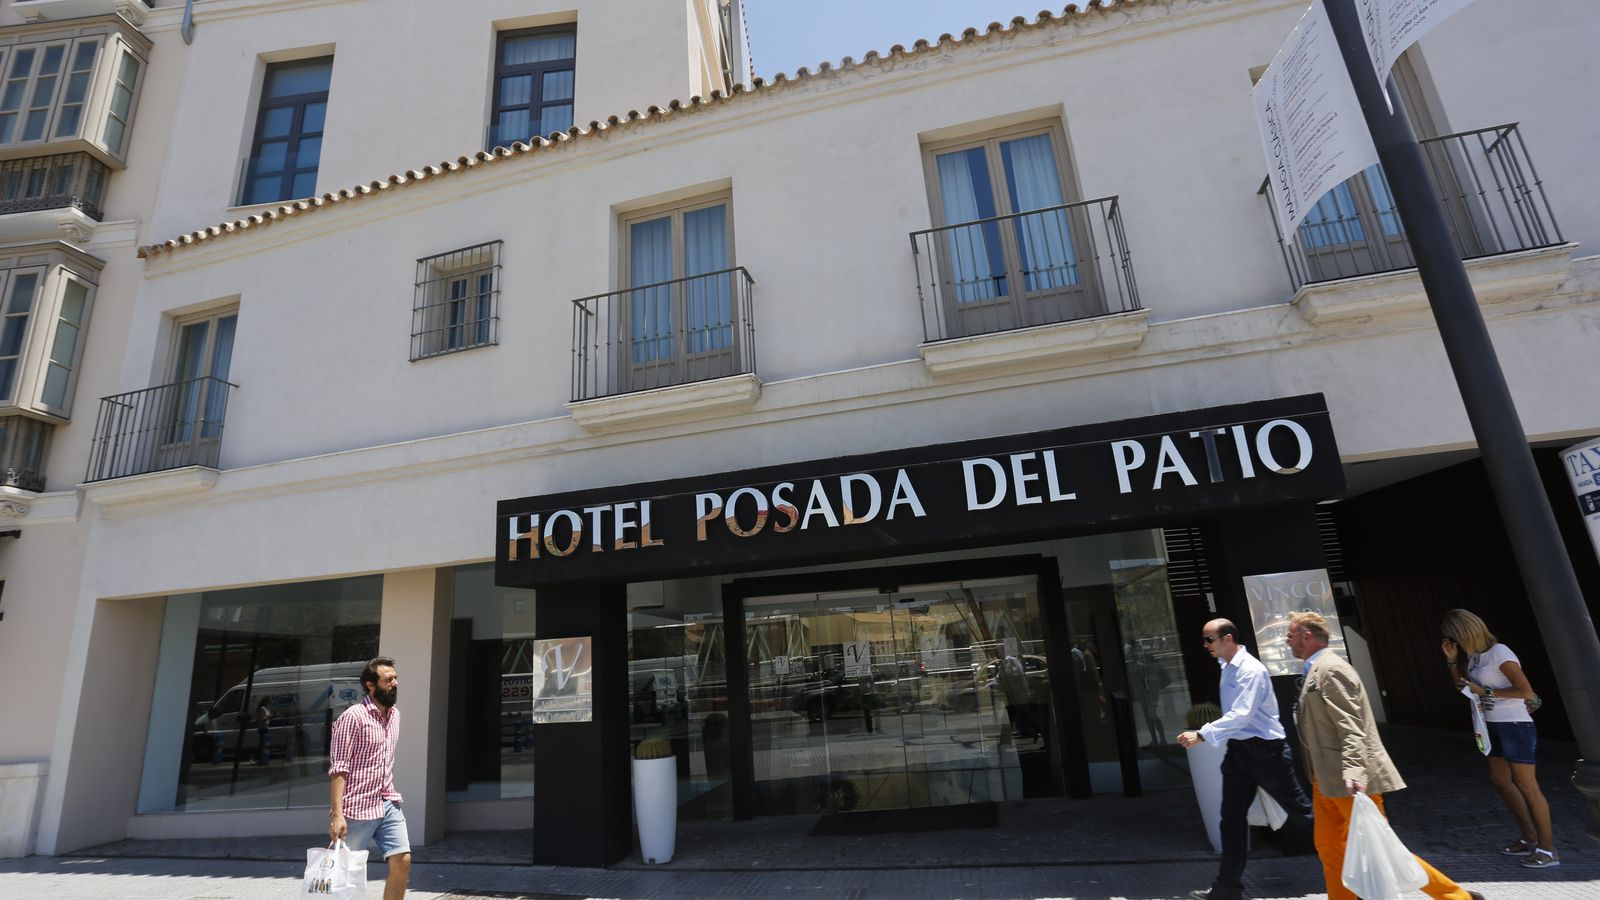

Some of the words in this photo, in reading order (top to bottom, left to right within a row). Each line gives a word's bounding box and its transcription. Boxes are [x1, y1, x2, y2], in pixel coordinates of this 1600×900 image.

[1265, 99, 1282, 158] CLÁSICA
[1278, 158, 1296, 221] MÁLAGA
[508, 500, 665, 561] HOTEL
[695, 468, 927, 542] POSADA
[962, 448, 1077, 511] DEL
[1110, 418, 1314, 494] PATIO
[1251, 580, 1329, 601] VINCCI
